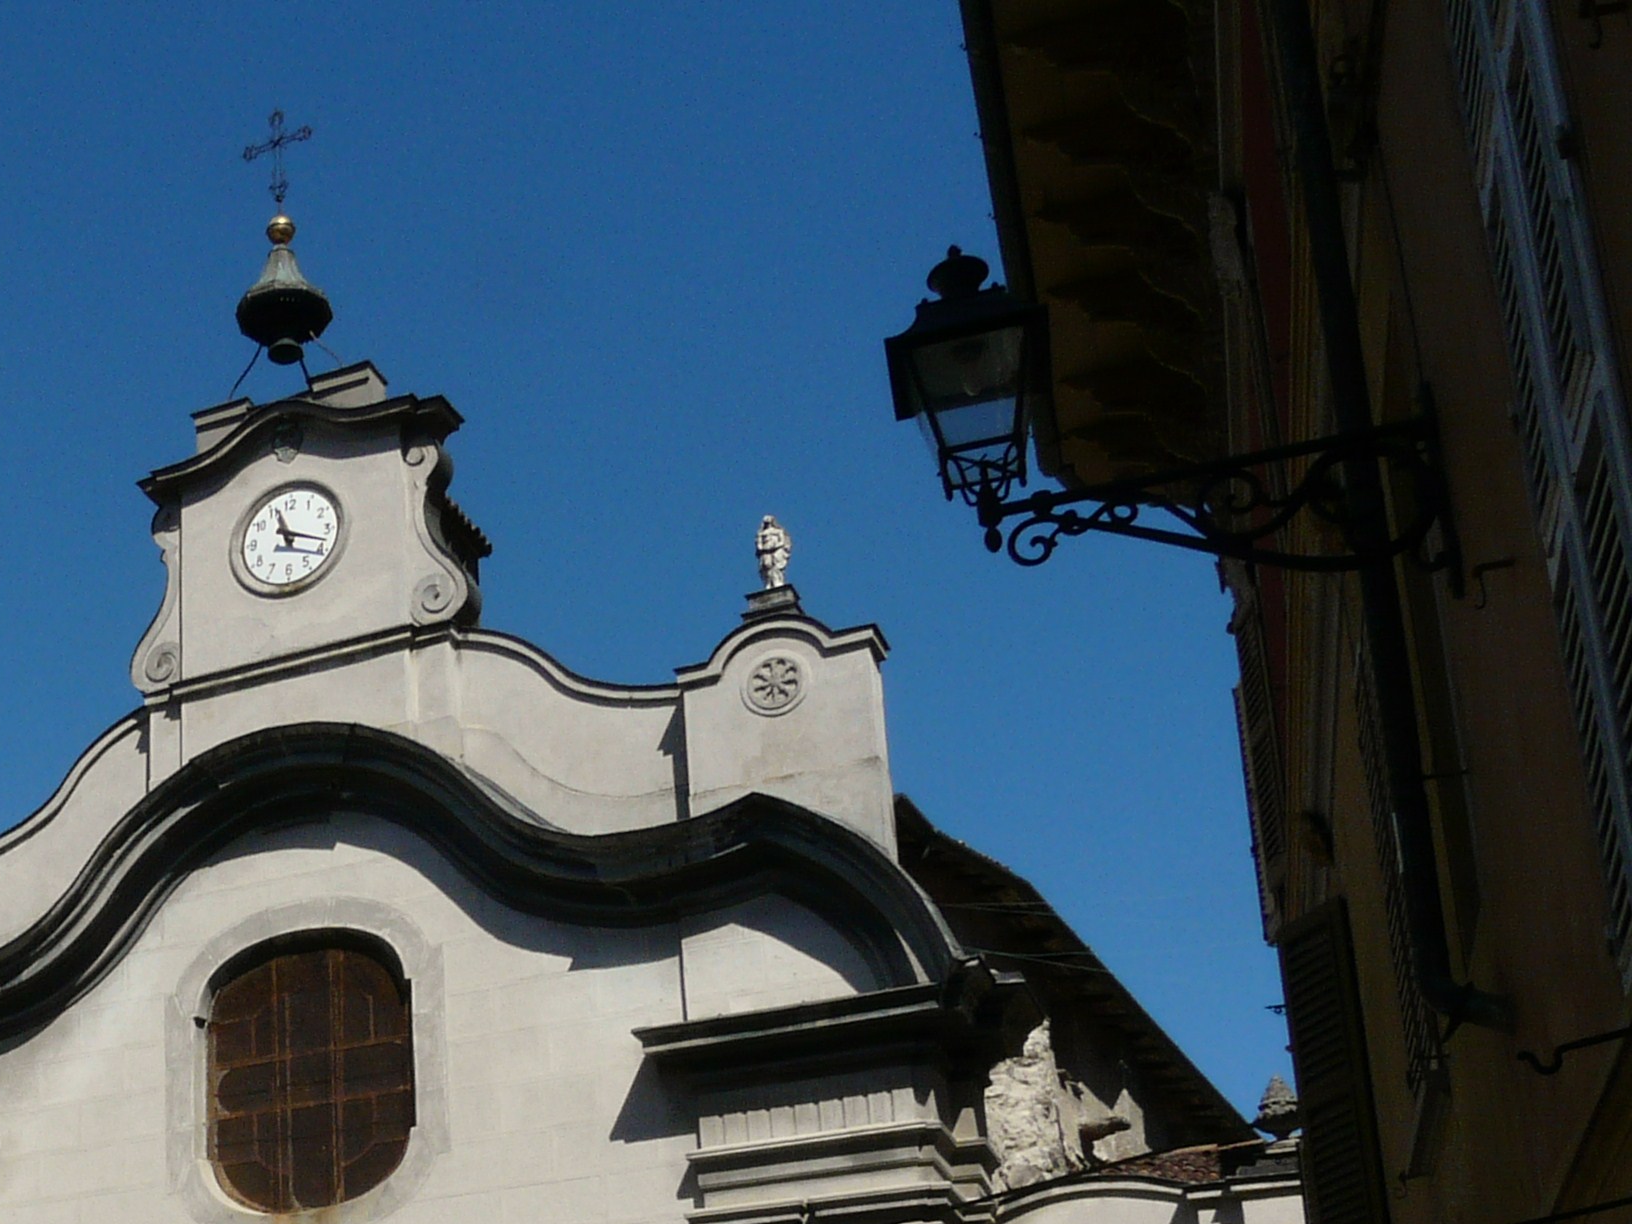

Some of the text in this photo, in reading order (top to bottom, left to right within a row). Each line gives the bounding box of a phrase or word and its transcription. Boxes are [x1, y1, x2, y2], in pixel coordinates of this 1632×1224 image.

[284, 499, 297, 511] 12
[306, 500, 311, 511] 1
[316, 507, 325, 519] 2
[256, 520, 266, 533] 10
[323, 523, 331, 535] 3
[250, 539, 257, 552] 9
[256, 554, 263, 567] 8
[302, 556, 309, 568] 5
[269, 563, 276, 575] 7
[285, 563, 293, 576] 6
